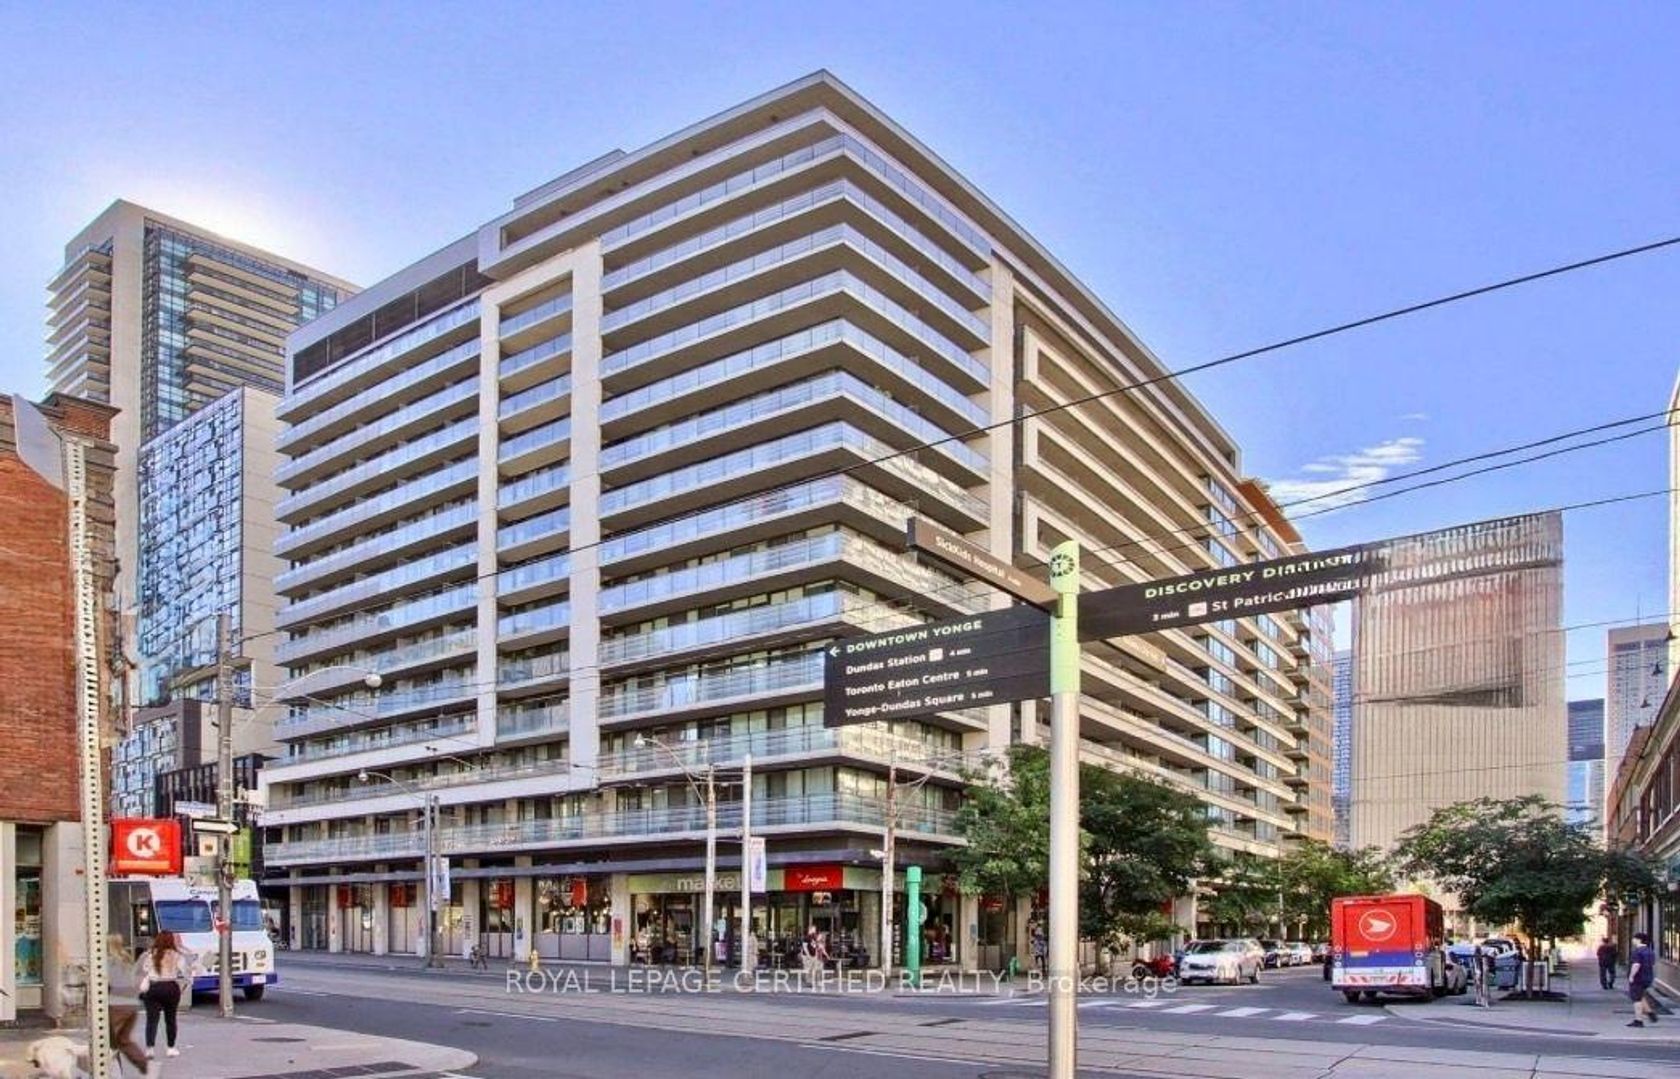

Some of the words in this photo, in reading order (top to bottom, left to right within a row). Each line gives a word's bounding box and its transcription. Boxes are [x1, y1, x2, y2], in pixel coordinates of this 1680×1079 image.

[1145, 571, 1255, 599] DISCOVERY
[1212, 601, 1228, 612] St
[846, 630, 928, 654] DOWNTOWN
[933, 620, 983, 636] YONGE
[846, 660, 884, 675] Dundas
[887, 652, 927, 668] Station
[844, 681, 886, 696] Toronto
[888, 675, 920, 690] Eaton
[922, 669, 960, 684] Centre
[845, 698, 922, 718] Yonge-Dundas
[924, 693, 965, 707] Square
[136, 835, 153, 851] K
